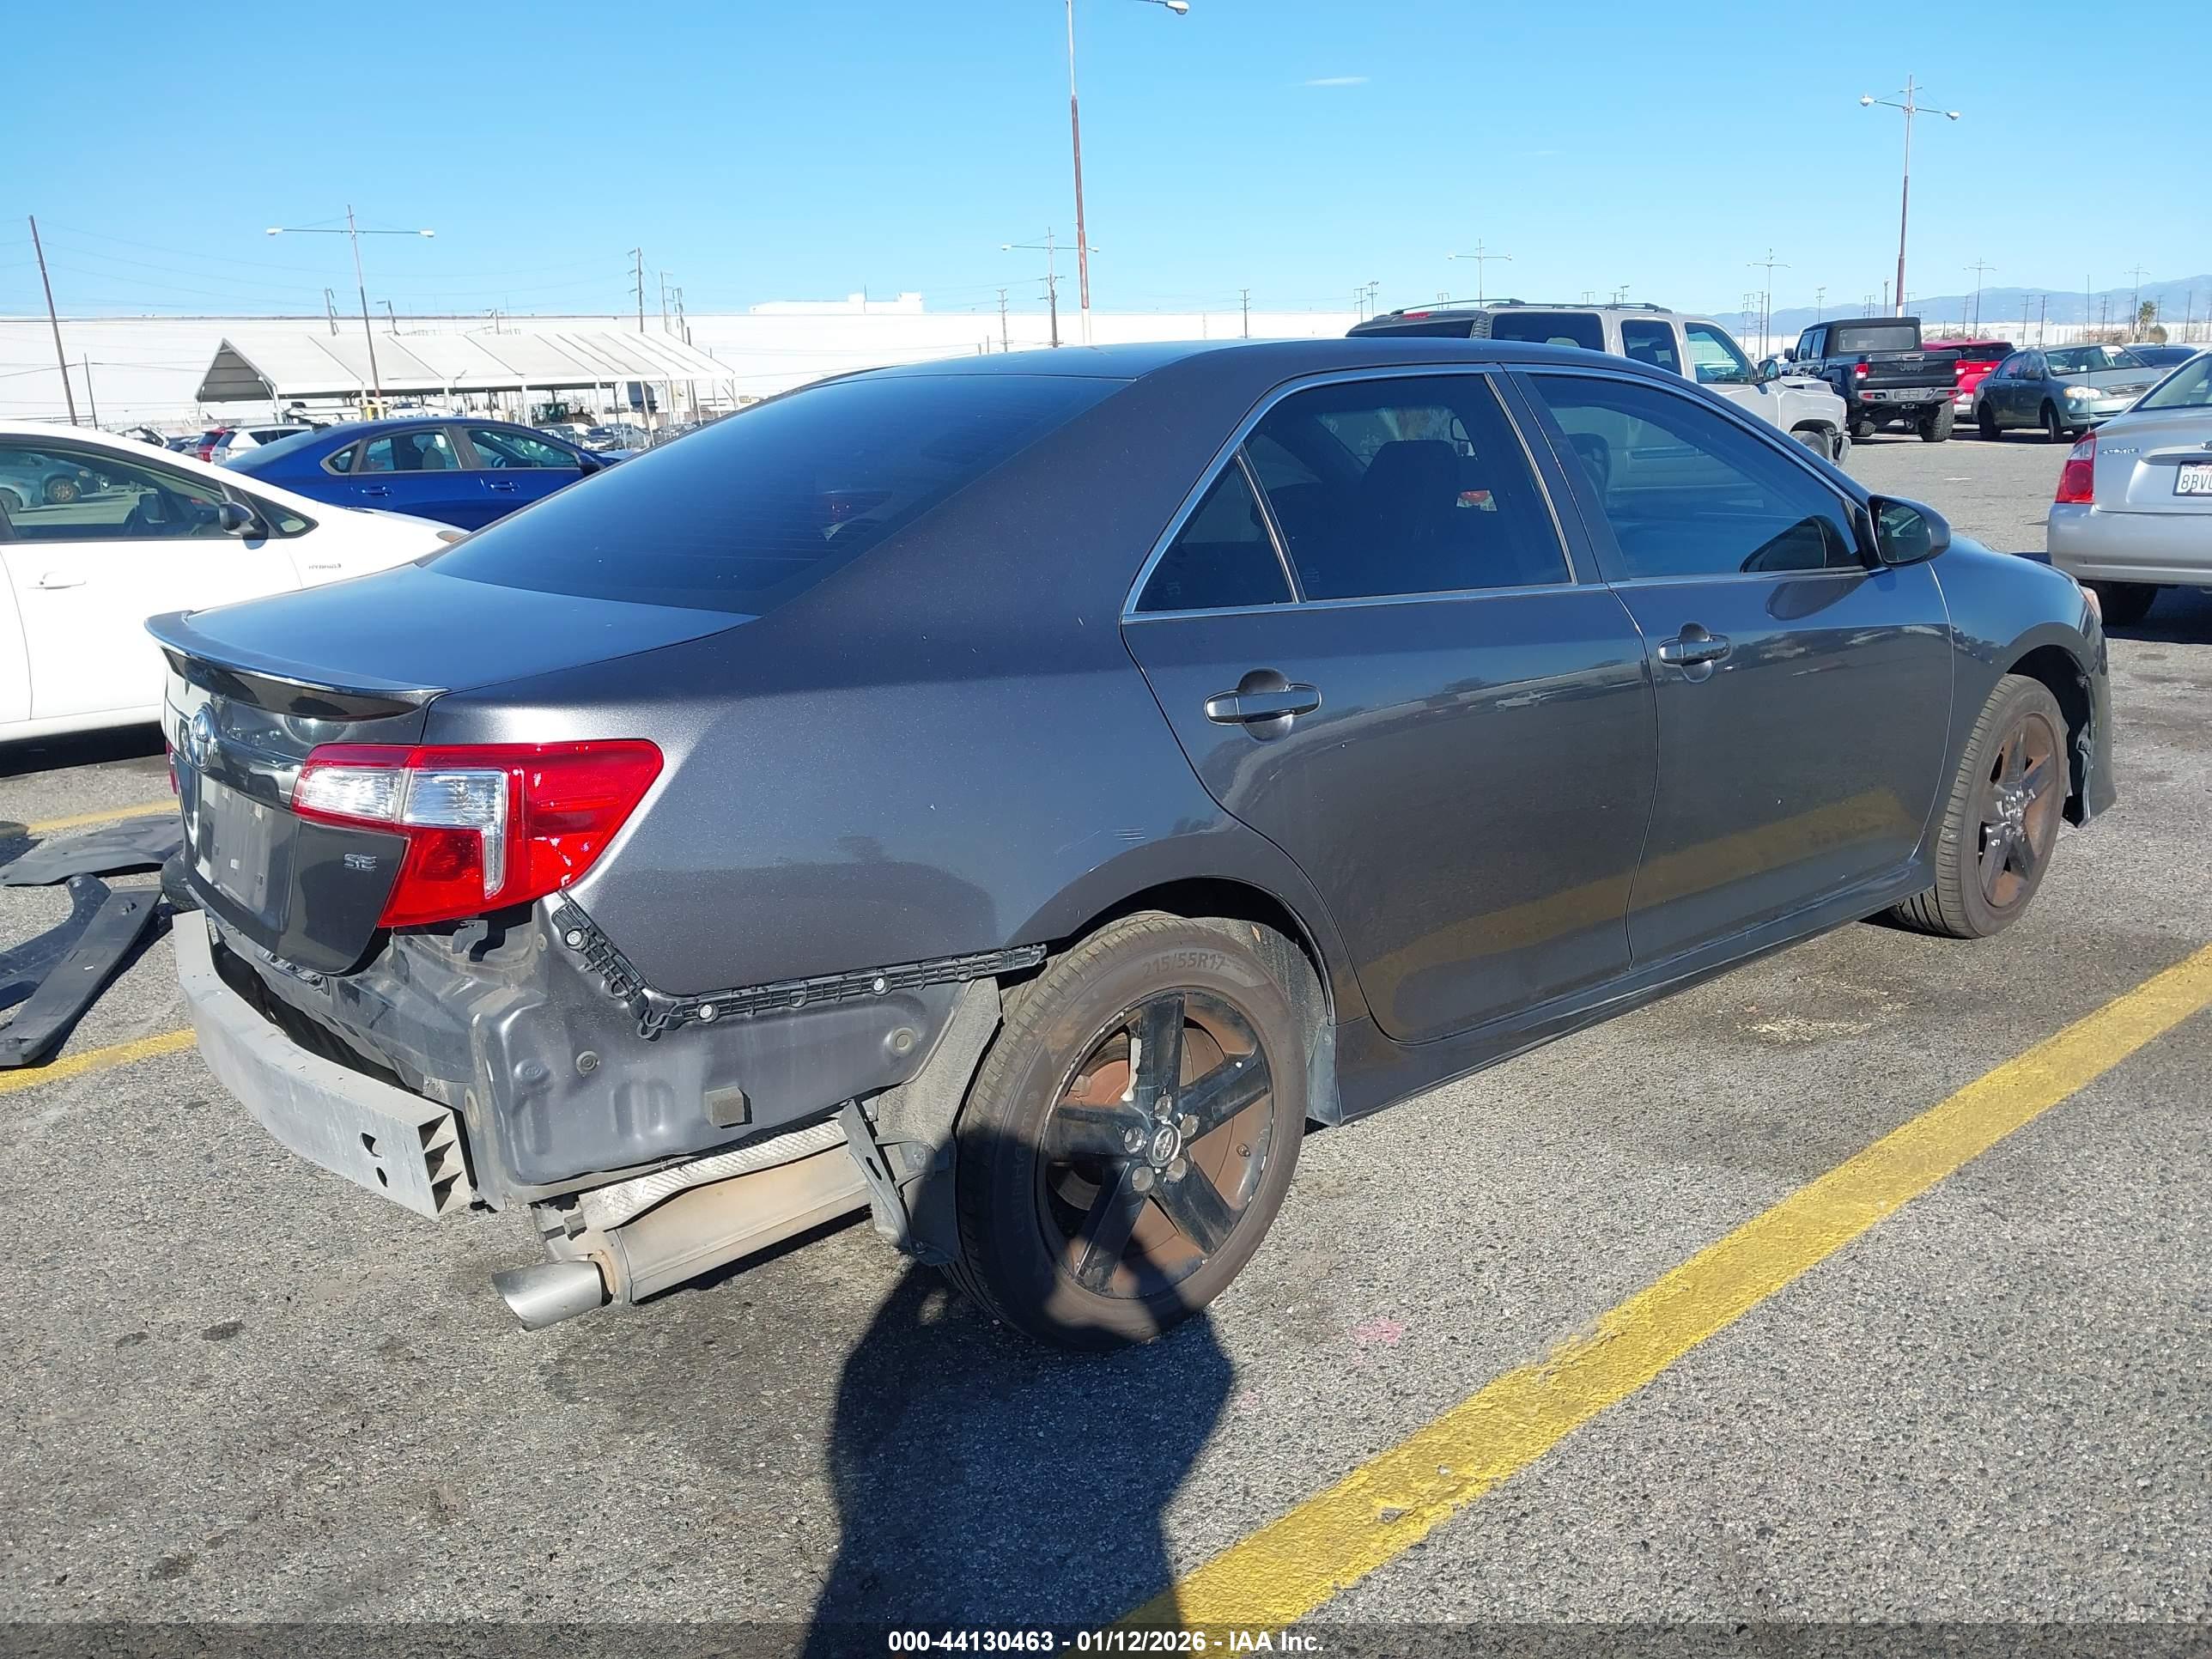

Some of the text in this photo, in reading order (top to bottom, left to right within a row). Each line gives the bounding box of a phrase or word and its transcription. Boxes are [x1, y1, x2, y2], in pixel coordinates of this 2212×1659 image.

[1899, 362, 1924, 373] Jeep
[344, 854, 377, 871] SE
[1143, 951, 1226, 979] 215/55R17
